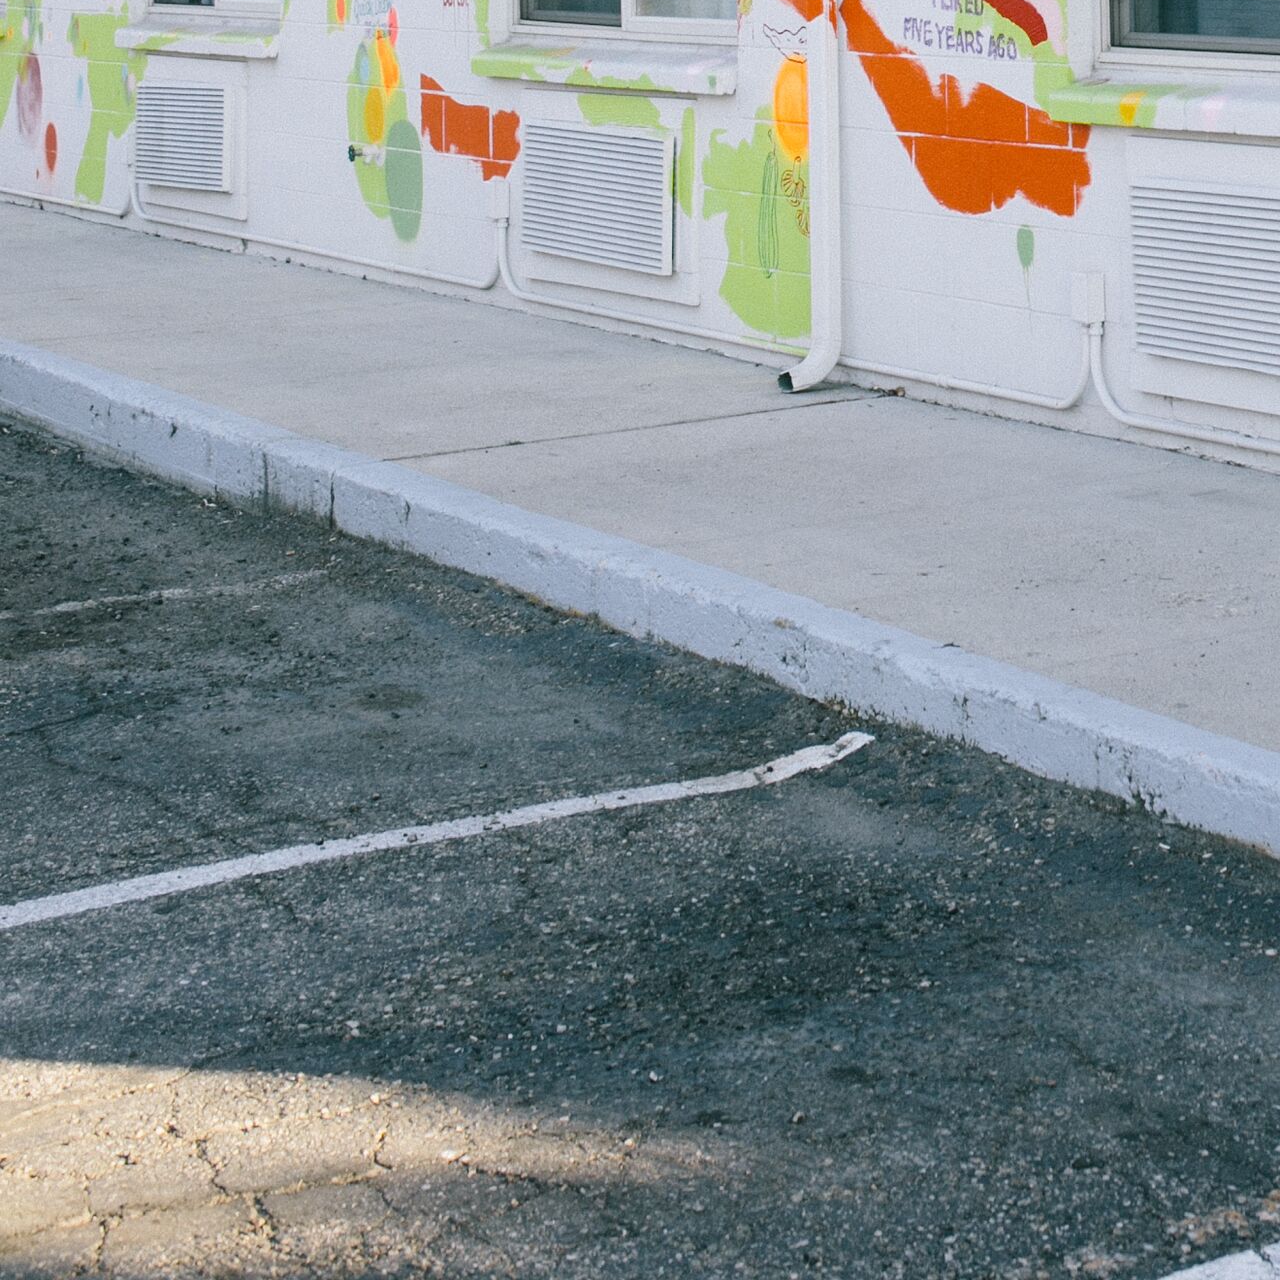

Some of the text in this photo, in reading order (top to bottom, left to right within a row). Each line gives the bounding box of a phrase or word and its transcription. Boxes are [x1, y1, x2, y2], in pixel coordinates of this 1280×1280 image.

[904, 17, 1018, 60] FIVE YEARS AGO
